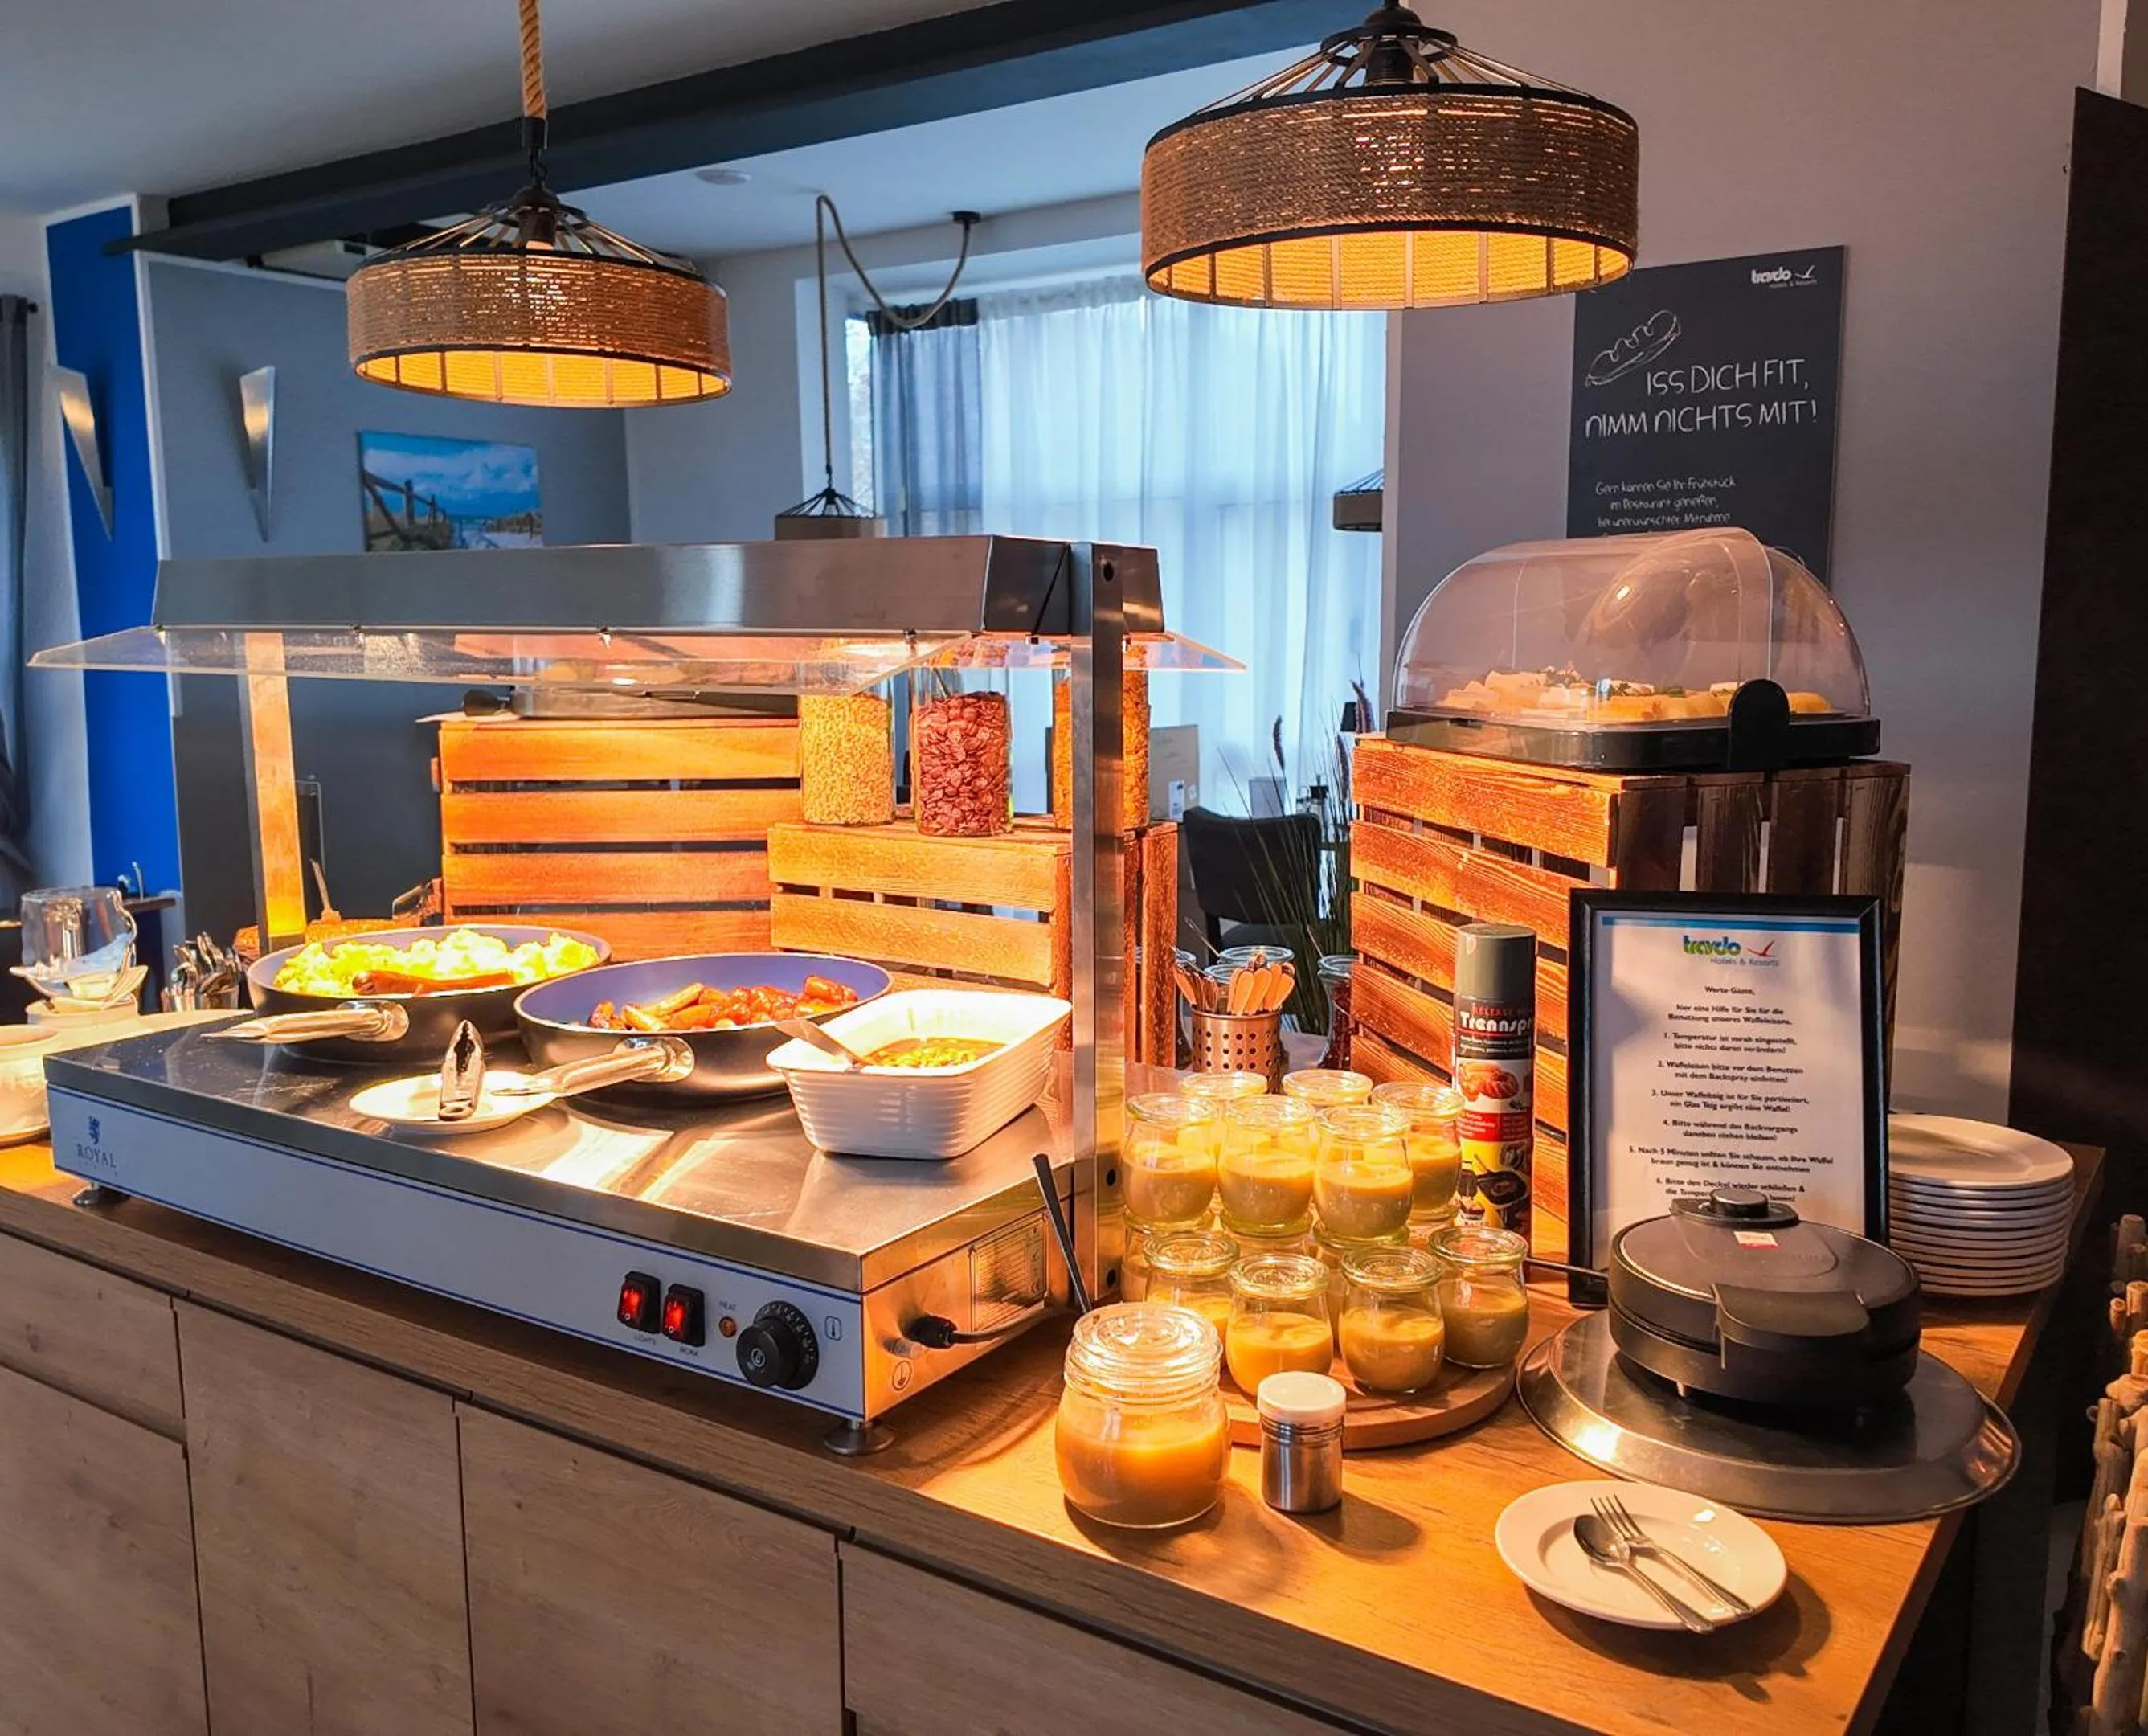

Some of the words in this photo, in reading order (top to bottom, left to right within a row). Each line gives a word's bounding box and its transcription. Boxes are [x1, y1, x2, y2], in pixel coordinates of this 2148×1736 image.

[1647, 370, 1684, 396] ISS
[1691, 359, 1757, 393] DICH
[1764, 358, 1809, 391] FIT,
[76, 1143, 117, 1169] ROYAL
